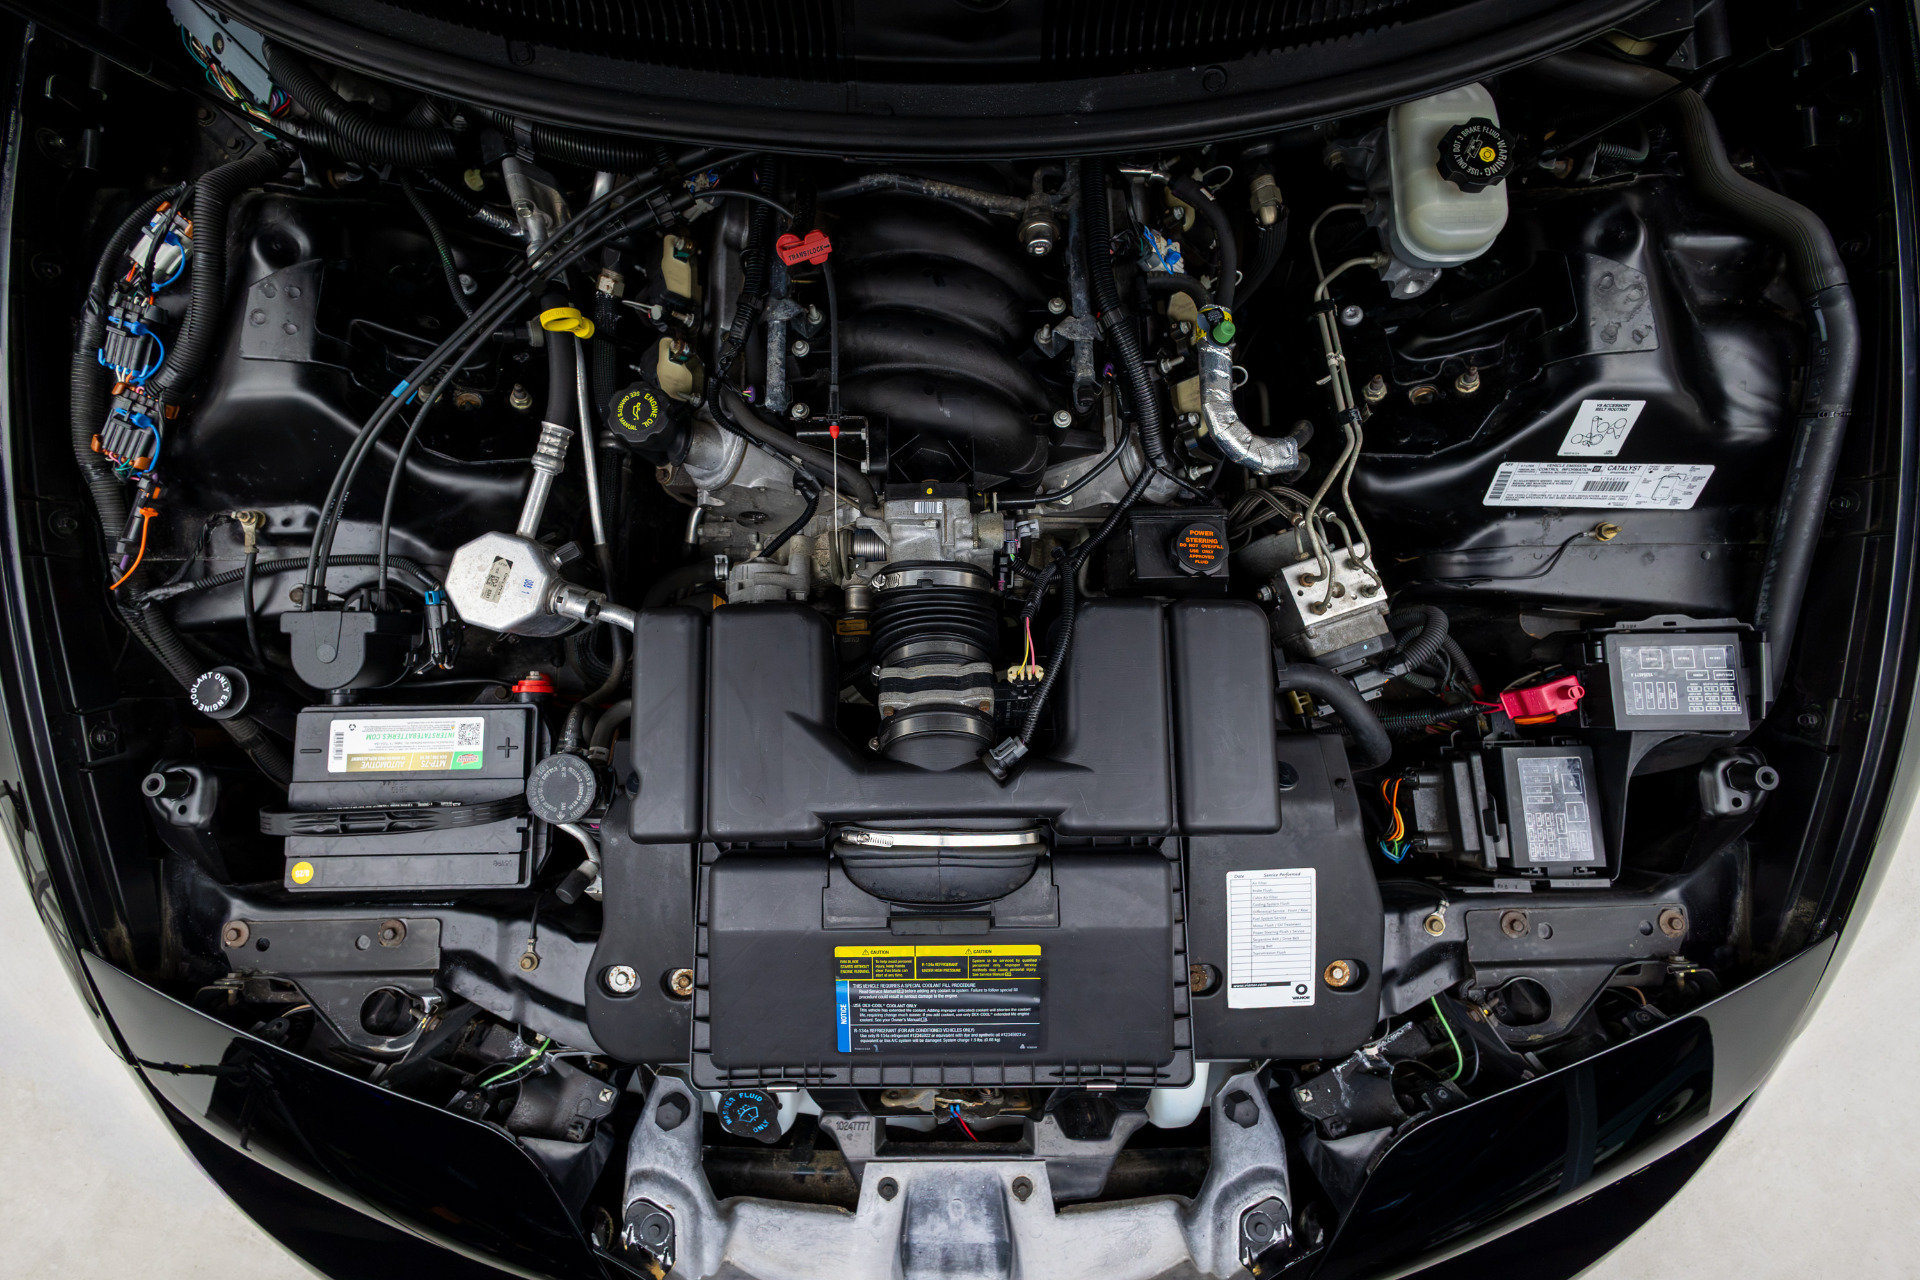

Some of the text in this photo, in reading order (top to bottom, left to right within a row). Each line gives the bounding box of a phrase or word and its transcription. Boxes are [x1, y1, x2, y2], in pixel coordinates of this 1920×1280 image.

[1460, 125, 1482, 138] BRAKE
[1482, 125, 1500, 138] FLUID
[1452, 139, 1461, 153] DOT
[1454, 153, 1468, 170] ONLY
[1485, 139, 1507, 177] WARNING
[1468, 167, 1479, 176] USE
[629, 390, 640, 398] SEE
[642, 393, 659, 428] ENGINE OIL
[618, 416, 638, 431] MANUAL
[190, 672, 230, 712] ENGINE COOLANT ONLY
[366, 732, 455, 740] INTERSTATEBATTERIES.COM
[420, 760, 447, 768] MTP-75
[722, 1092, 770, 1133] WASHER FLUID ONLY
[836, 1121, 870, 1131] 10247777
